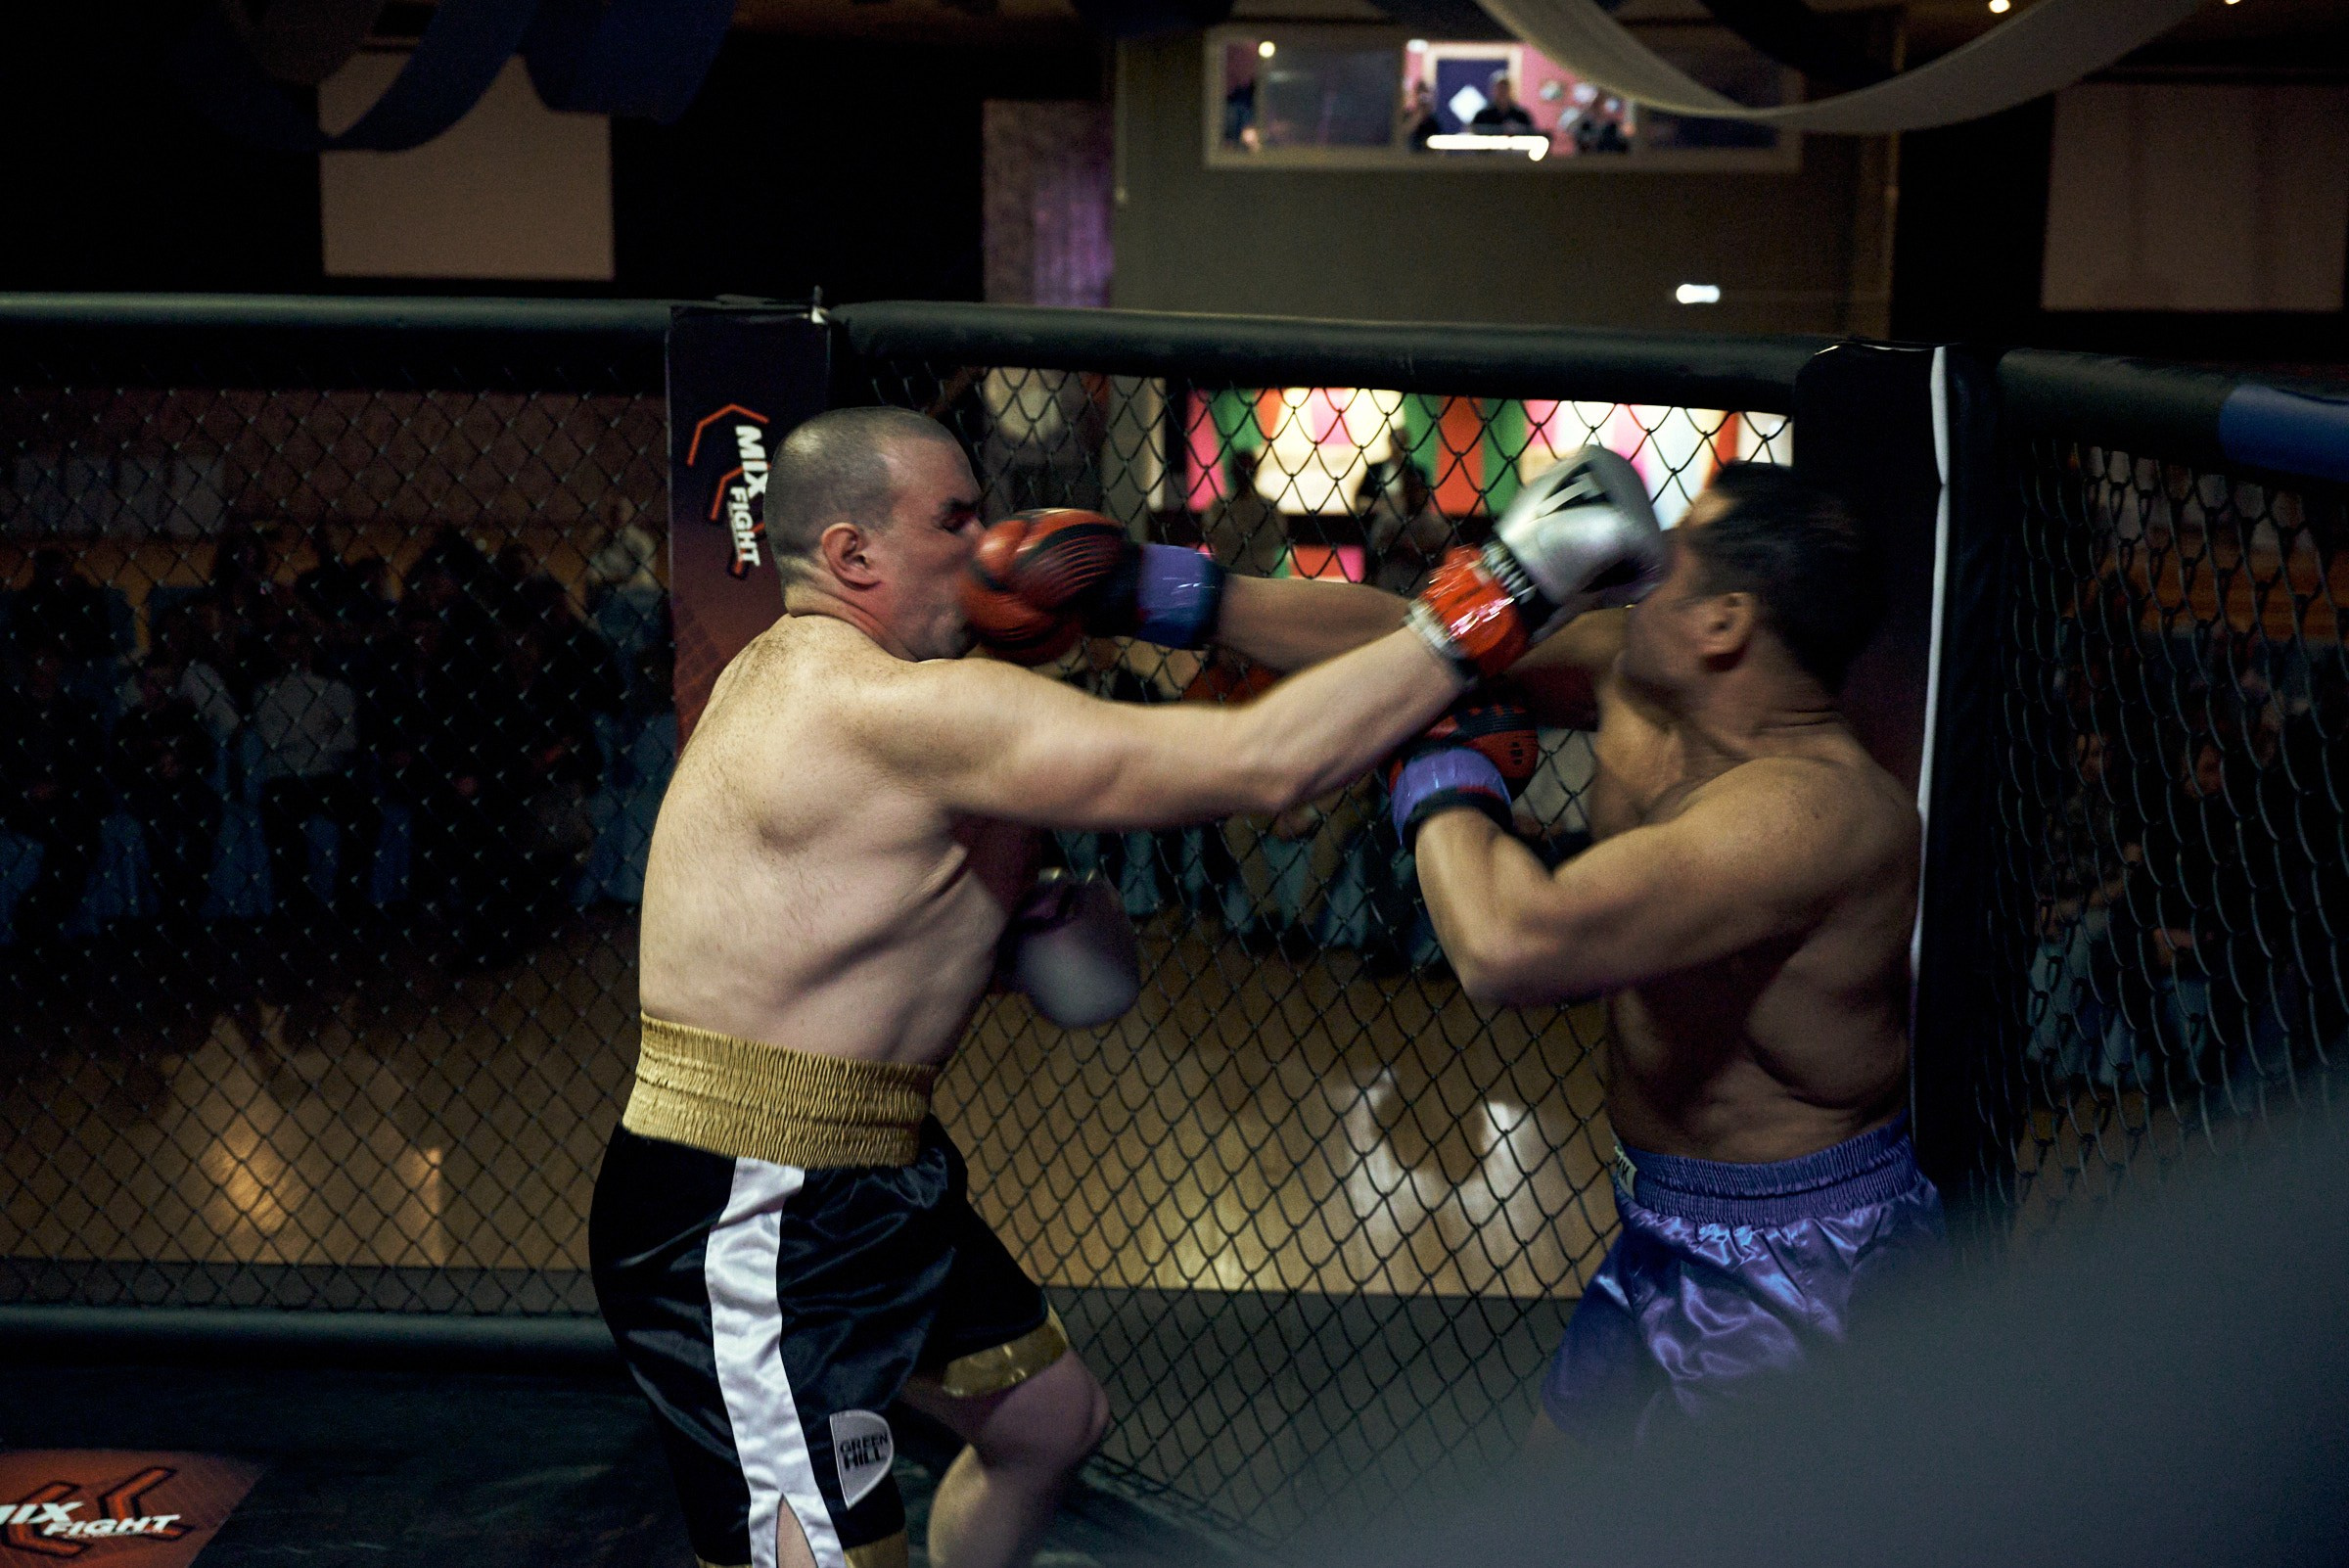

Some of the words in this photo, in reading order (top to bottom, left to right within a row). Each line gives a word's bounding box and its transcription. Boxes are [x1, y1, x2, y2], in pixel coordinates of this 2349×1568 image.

[735, 425, 769, 499] MIX
[730, 485, 761, 567] FIGHT
[843, 1447, 887, 1470] HILL
[43, 1514, 181, 1536] FIGHT
